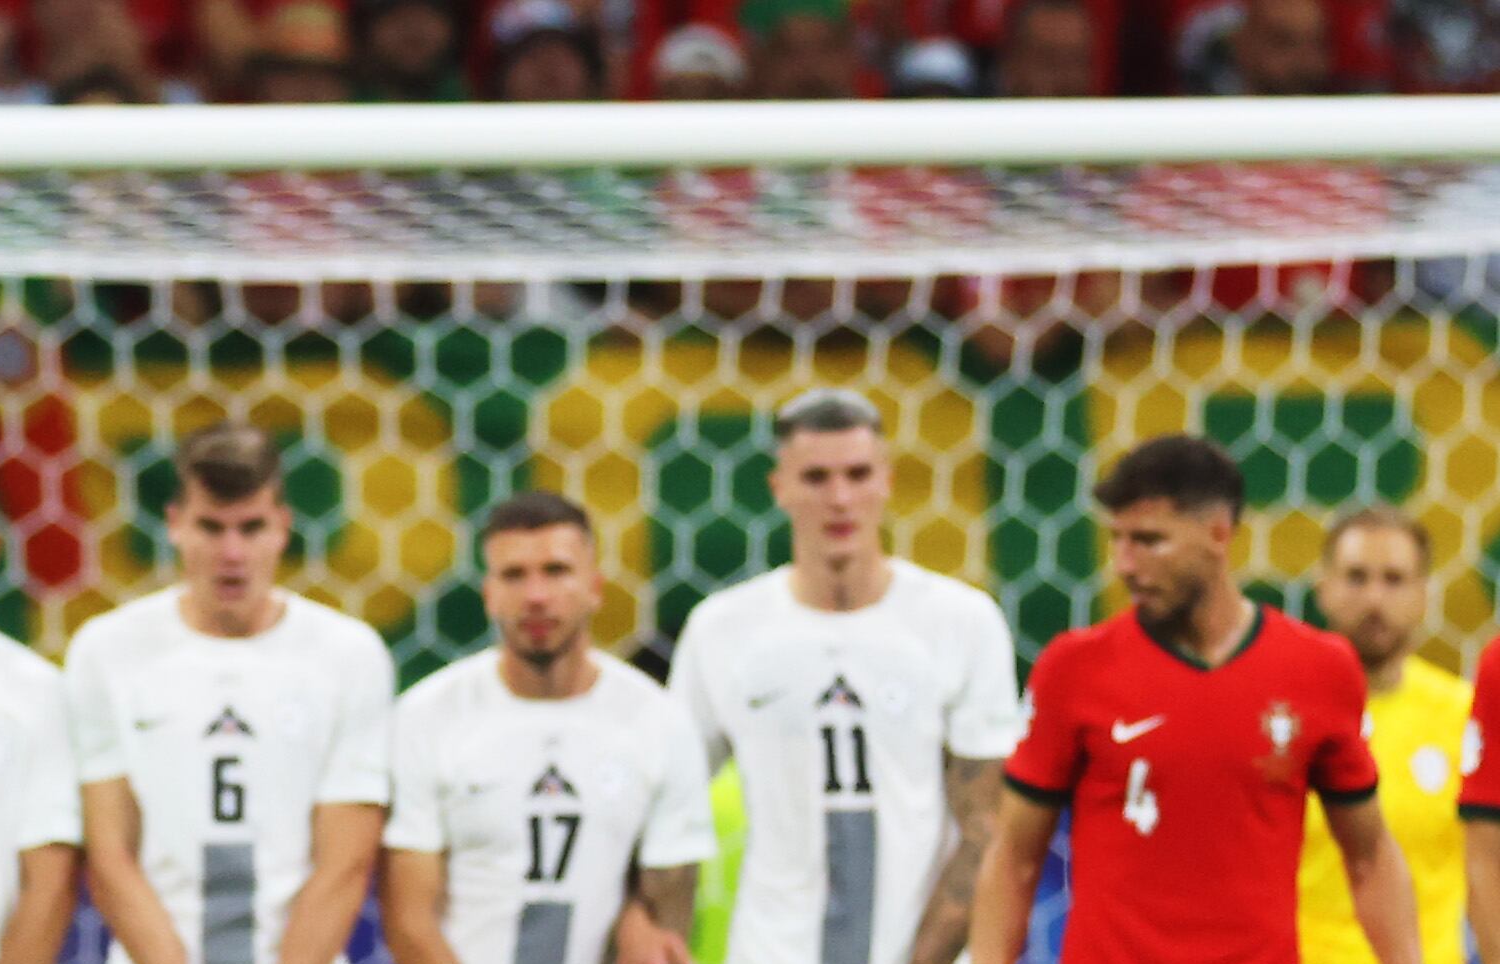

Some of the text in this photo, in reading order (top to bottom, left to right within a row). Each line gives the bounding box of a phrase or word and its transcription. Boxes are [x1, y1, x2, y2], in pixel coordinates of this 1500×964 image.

[212, 756, 245, 824] 6
[819, 724, 873, 795] 11
[1122, 758, 1160, 836] 4
[524, 812, 583, 884] 17
